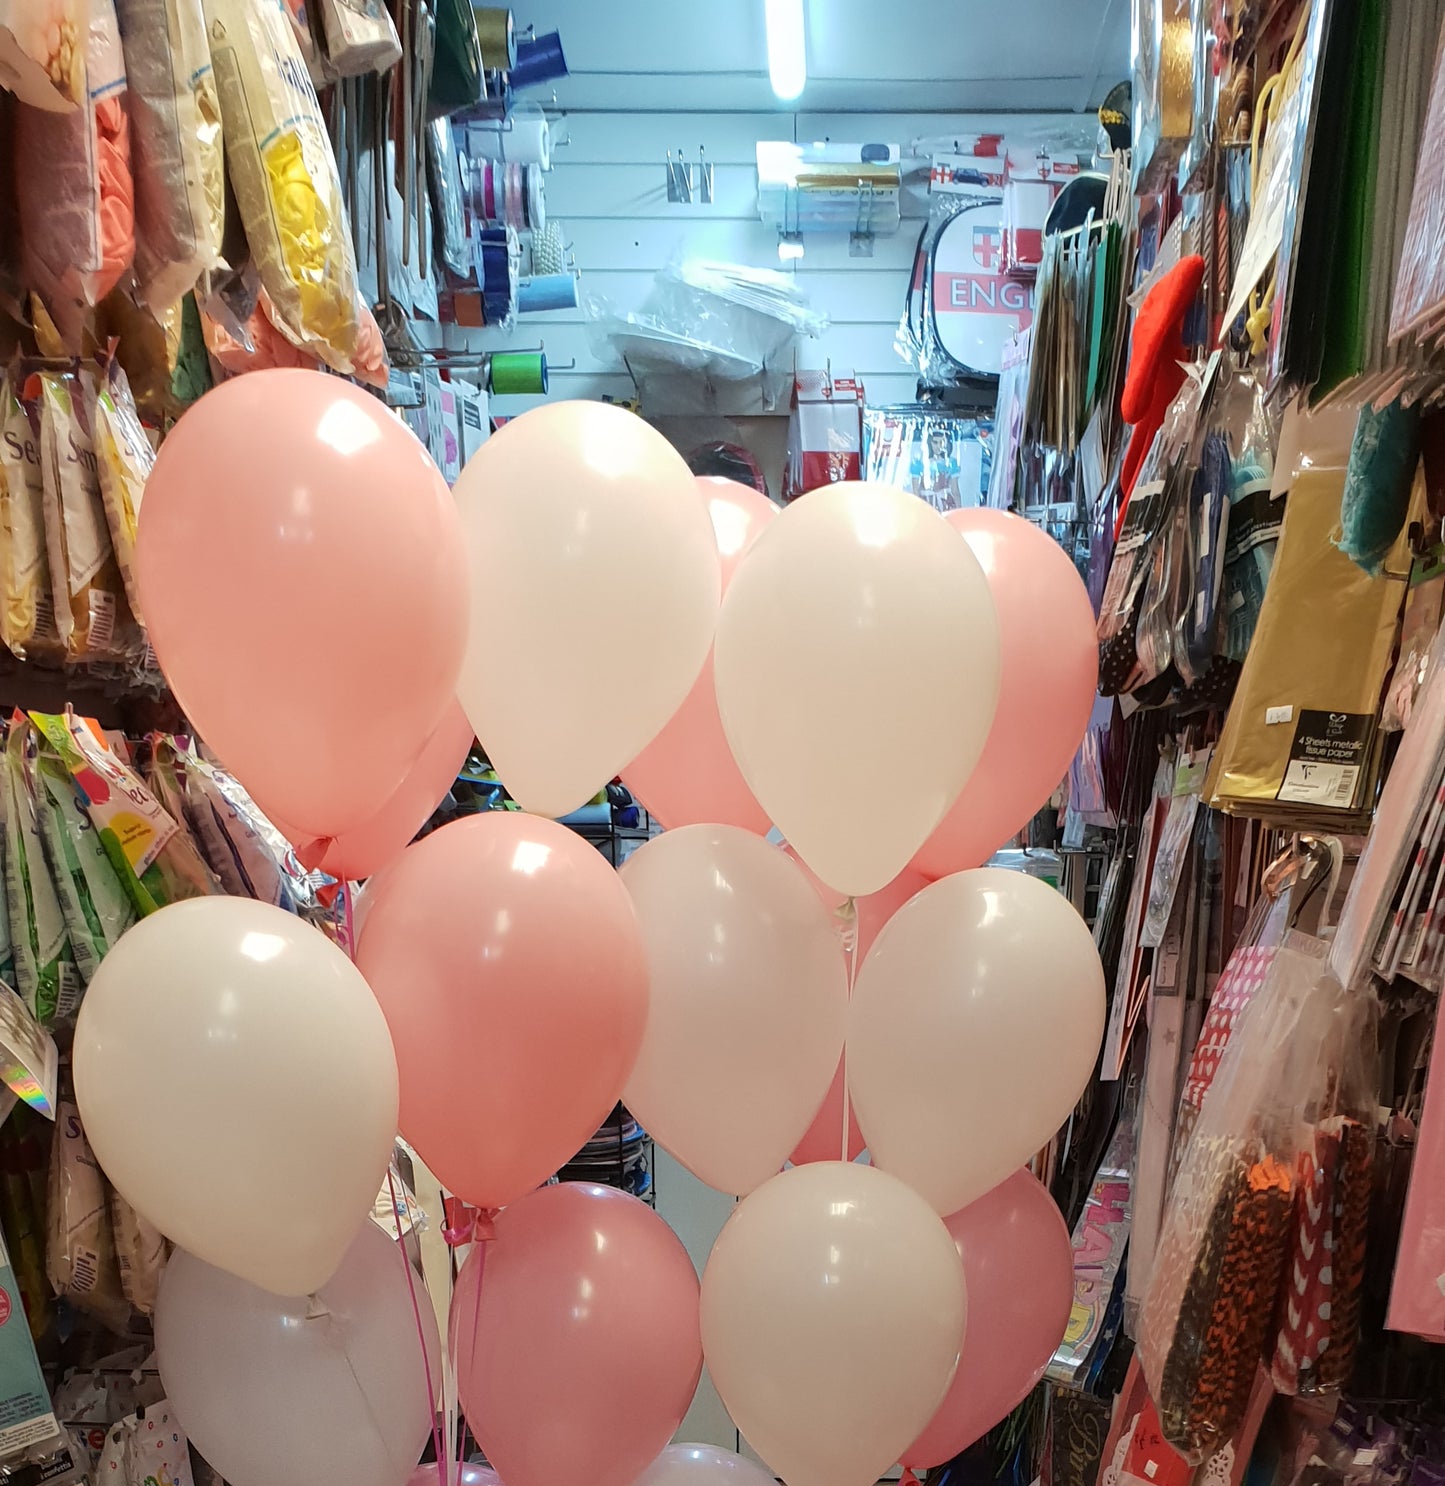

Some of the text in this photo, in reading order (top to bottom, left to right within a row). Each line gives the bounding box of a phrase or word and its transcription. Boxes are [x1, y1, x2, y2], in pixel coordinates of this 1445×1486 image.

[1298, 736, 1364, 750] 4 Sheets metallic
[1305, 745, 1354, 759] tissue paper
